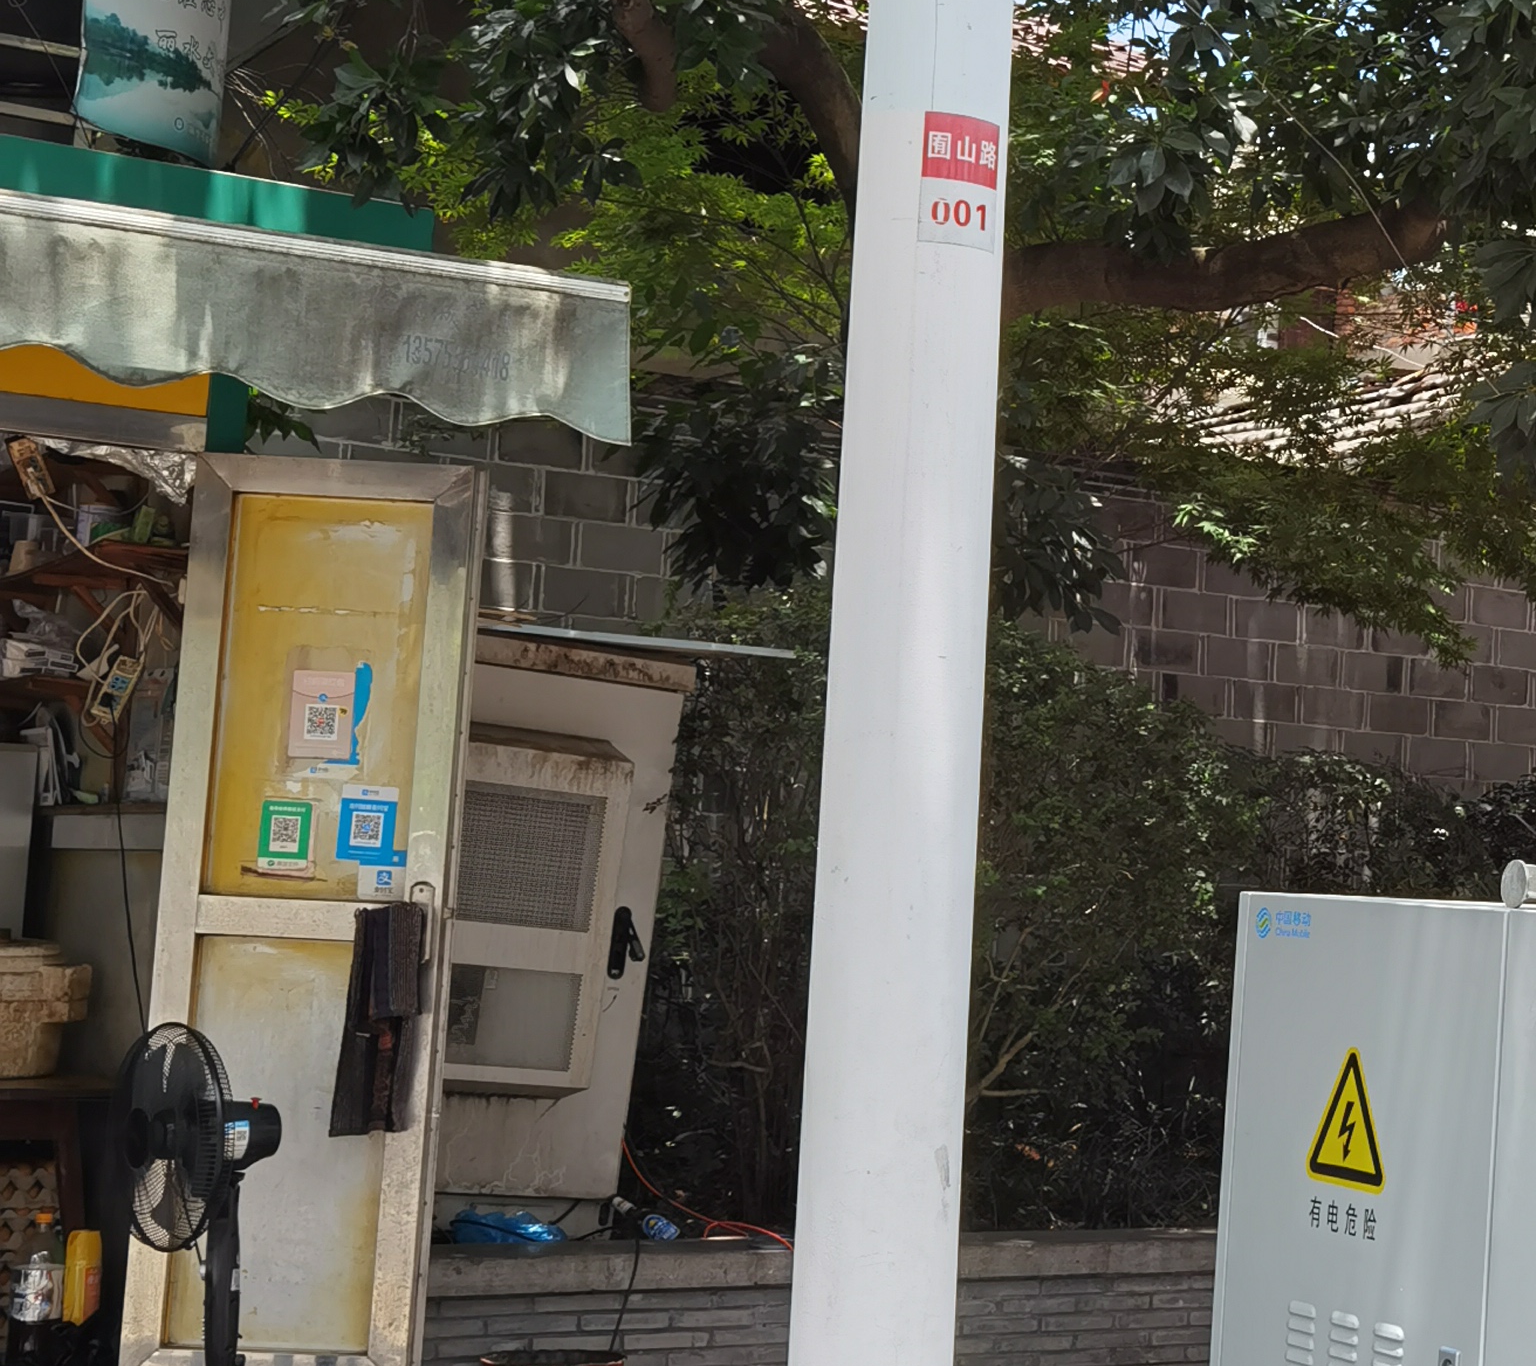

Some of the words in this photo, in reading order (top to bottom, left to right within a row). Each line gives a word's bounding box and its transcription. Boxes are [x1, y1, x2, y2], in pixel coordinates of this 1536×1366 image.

[927, 131, 997, 170] 囿山路
[931, 198, 987, 231] 001
[1275, 910, 1312, 927] 中国移动
[1308, 1195, 1377, 1241] 有电危险
